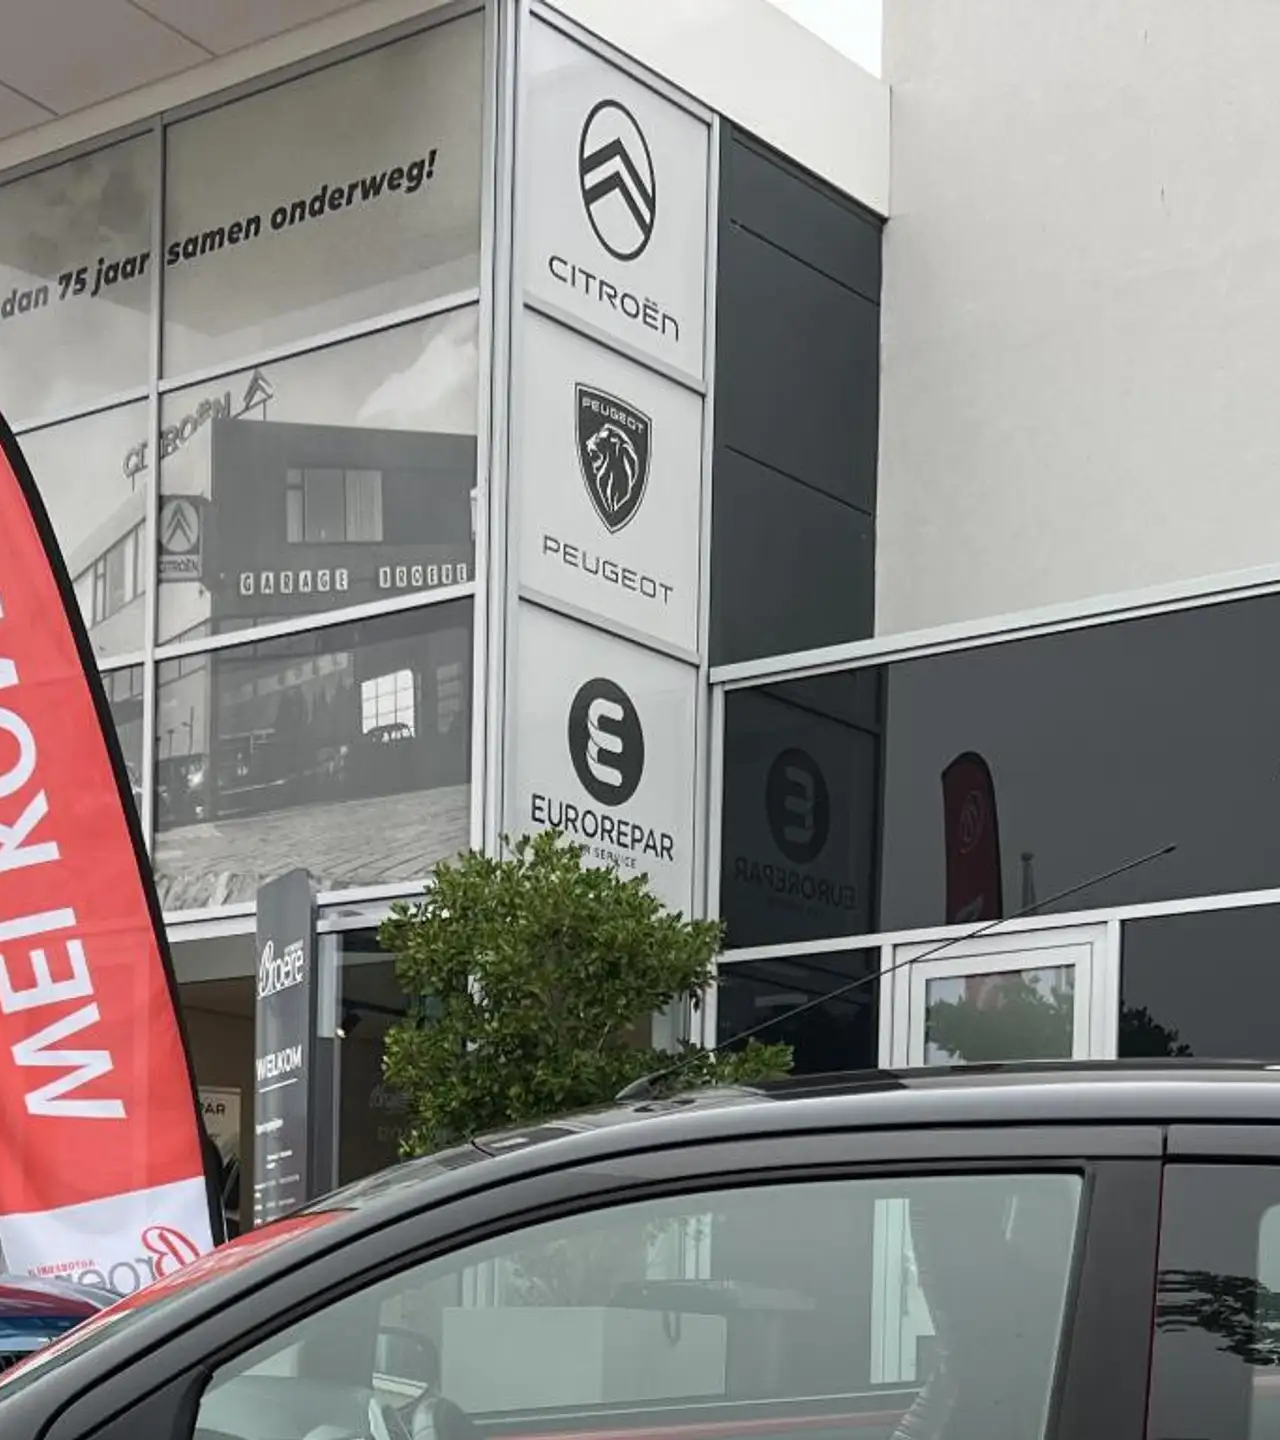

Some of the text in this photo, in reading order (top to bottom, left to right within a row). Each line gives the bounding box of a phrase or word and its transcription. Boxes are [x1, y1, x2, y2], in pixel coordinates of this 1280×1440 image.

[1, 281, 49, 319] dan
[58, 266, 88, 300] 75
[91, 250, 151, 298] jaar
[167, 213, 261, 267] samen
[271, 149, 438, 232] onderweg!
[548, 253, 680, 343] CITROËN
[581, 396, 645, 435] PEUGEOT
[240, 569, 349, 595] GARAGE
[542, 534, 675, 605] PEUGEOT
[531, 793, 675, 862] EUROREPAR
[255, 1044, 302, 1082] WELKOM
